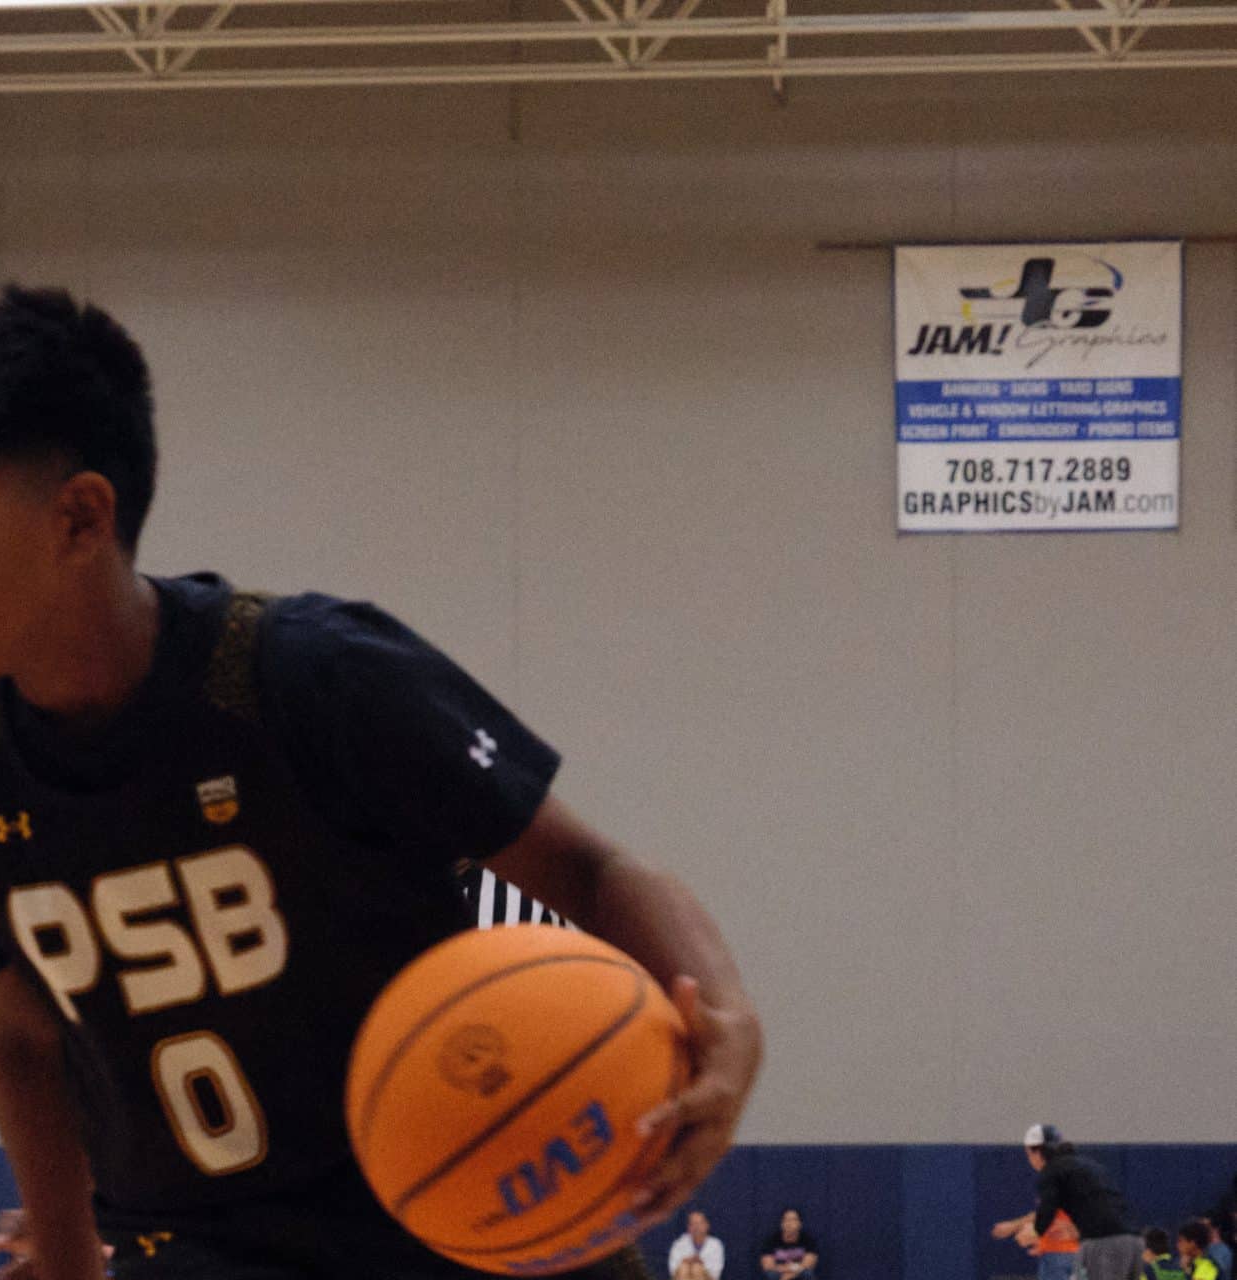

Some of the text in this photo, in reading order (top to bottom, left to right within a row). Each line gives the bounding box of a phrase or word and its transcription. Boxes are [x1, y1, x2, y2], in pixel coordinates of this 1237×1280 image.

[907, 321, 1167, 369] JAM! Graphics
[946, 457, 1131, 483] 708.717.2889
[904, 490, 1174, 519] GRAPHICSbyJAM.com
[7, 843, 290, 1025] PSB
[150, 1029, 269, 1178] 0
